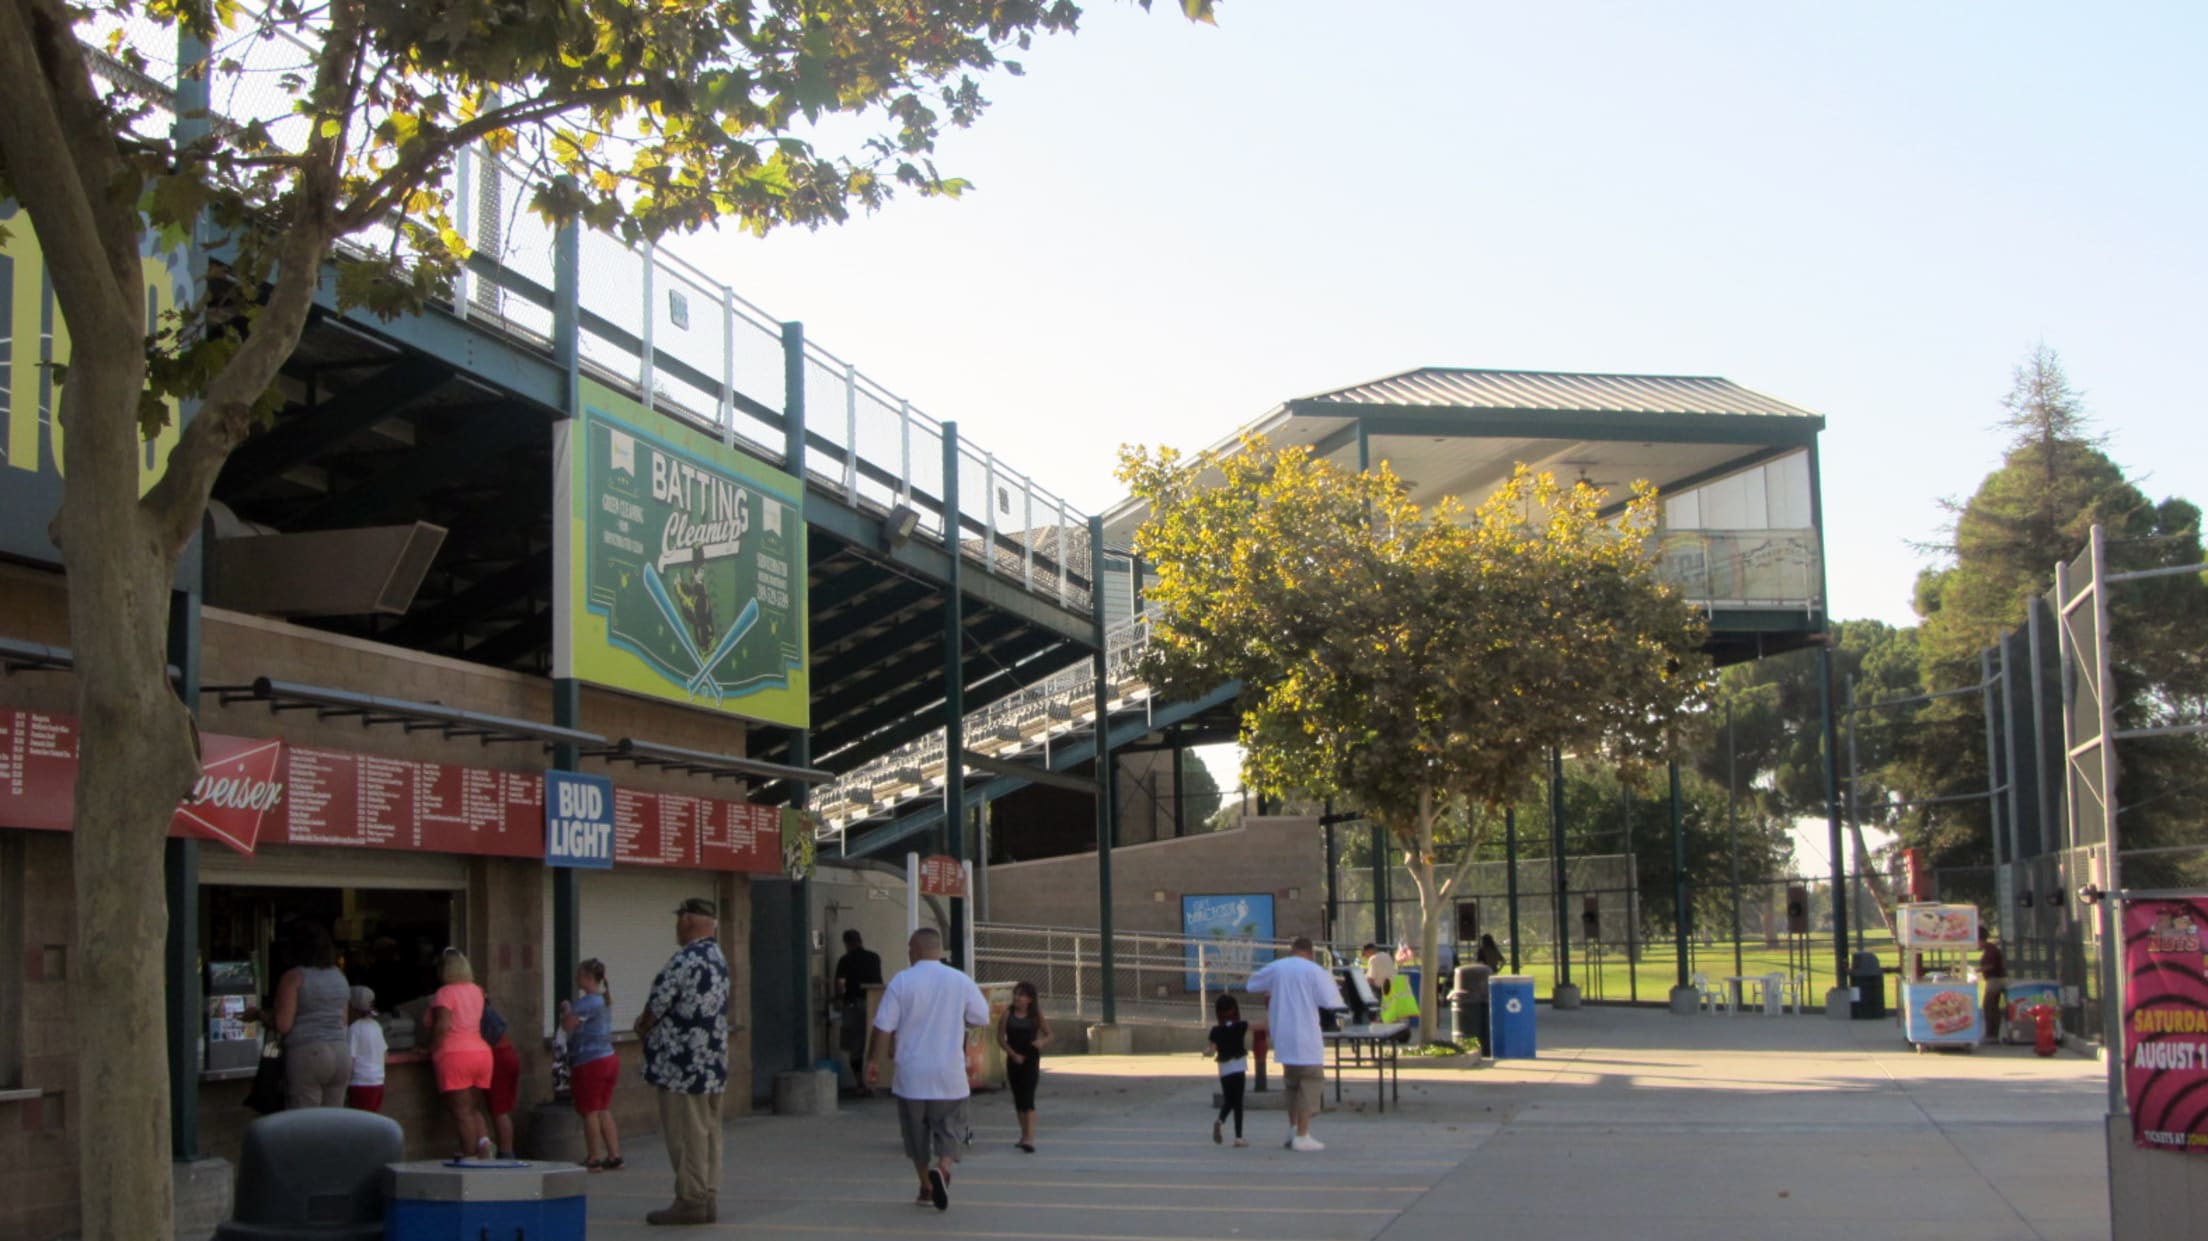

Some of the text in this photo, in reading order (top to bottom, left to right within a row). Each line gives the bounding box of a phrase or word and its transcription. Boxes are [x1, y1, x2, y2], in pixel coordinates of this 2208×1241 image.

[652, 451, 749, 533] BATTING
[662, 512, 741, 553] Cleanup
[558, 781, 603, 820] BUD
[550, 819, 611, 858] LIGHT
[2134, 1009, 2208, 1033] SATURDA
[2134, 1042, 2195, 1069] AUGUST
